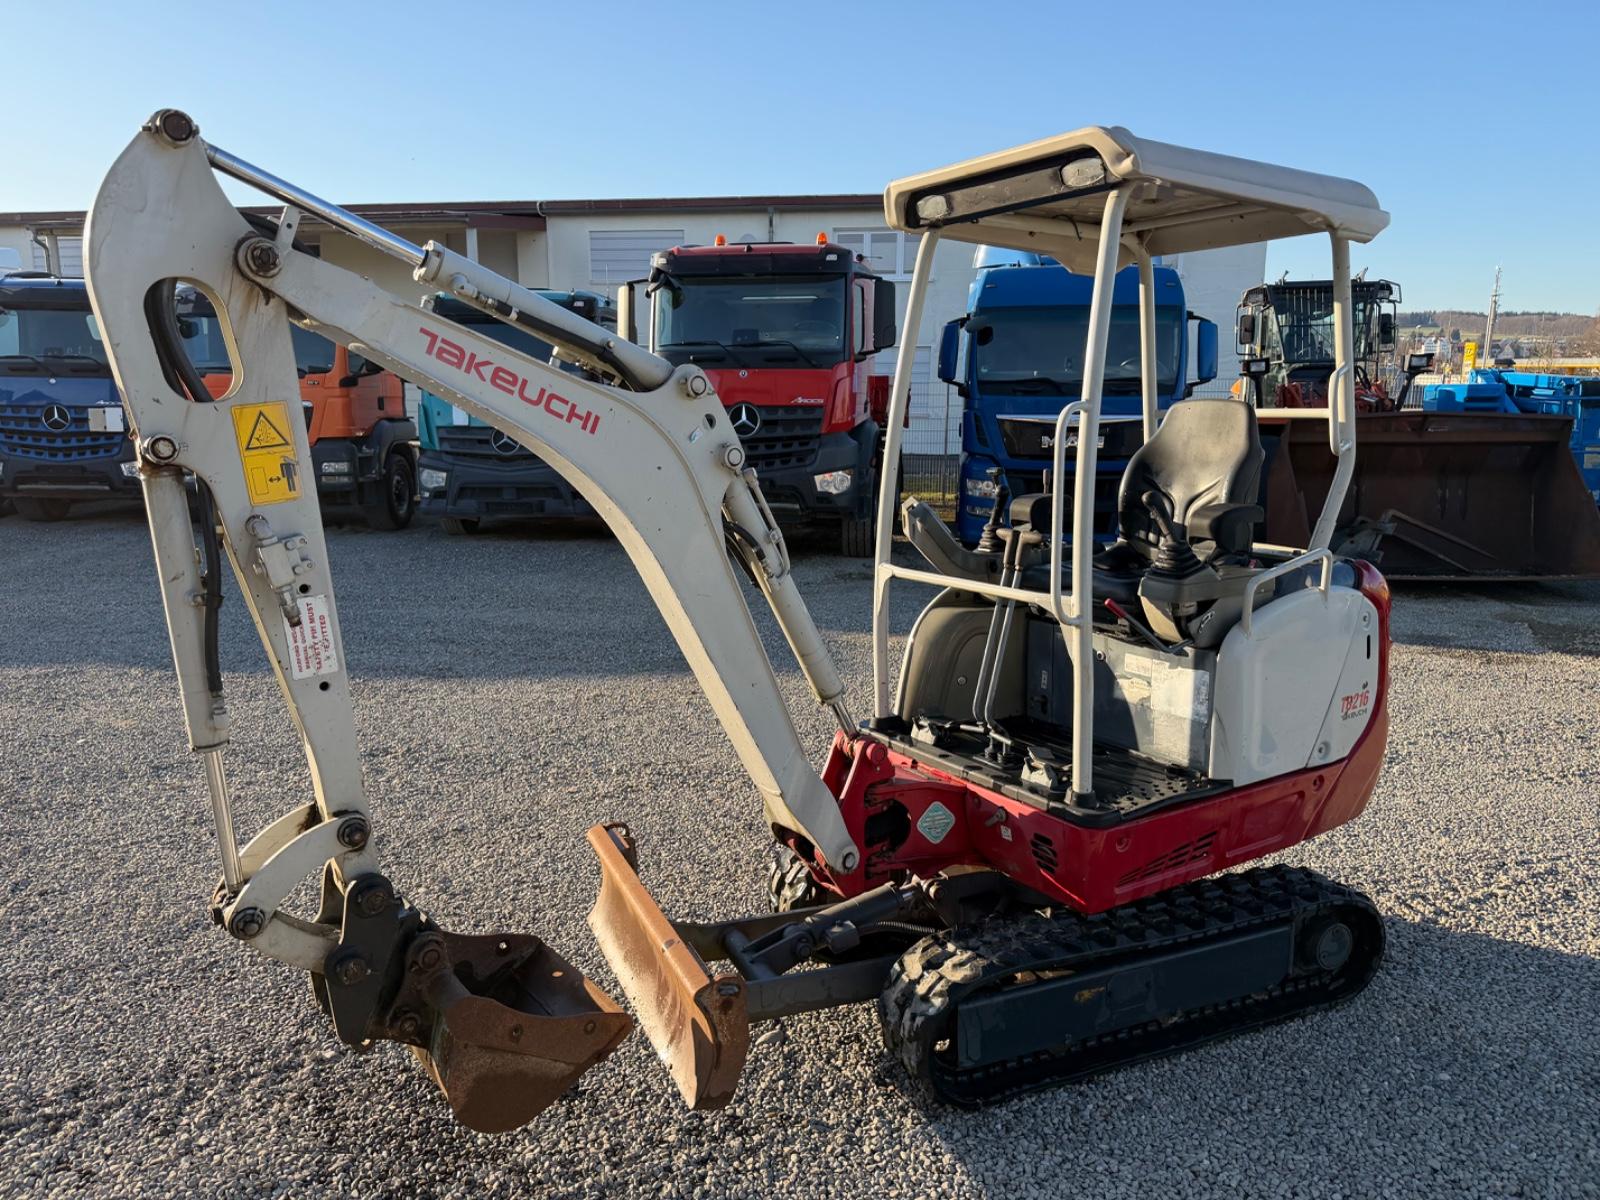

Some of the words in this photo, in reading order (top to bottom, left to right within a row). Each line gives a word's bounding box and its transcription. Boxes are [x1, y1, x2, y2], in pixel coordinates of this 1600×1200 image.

[419, 327, 600, 435] TAKEUCHI
[1041, 435, 1105, 448] MA
[306, 602, 315, 624] MUST
